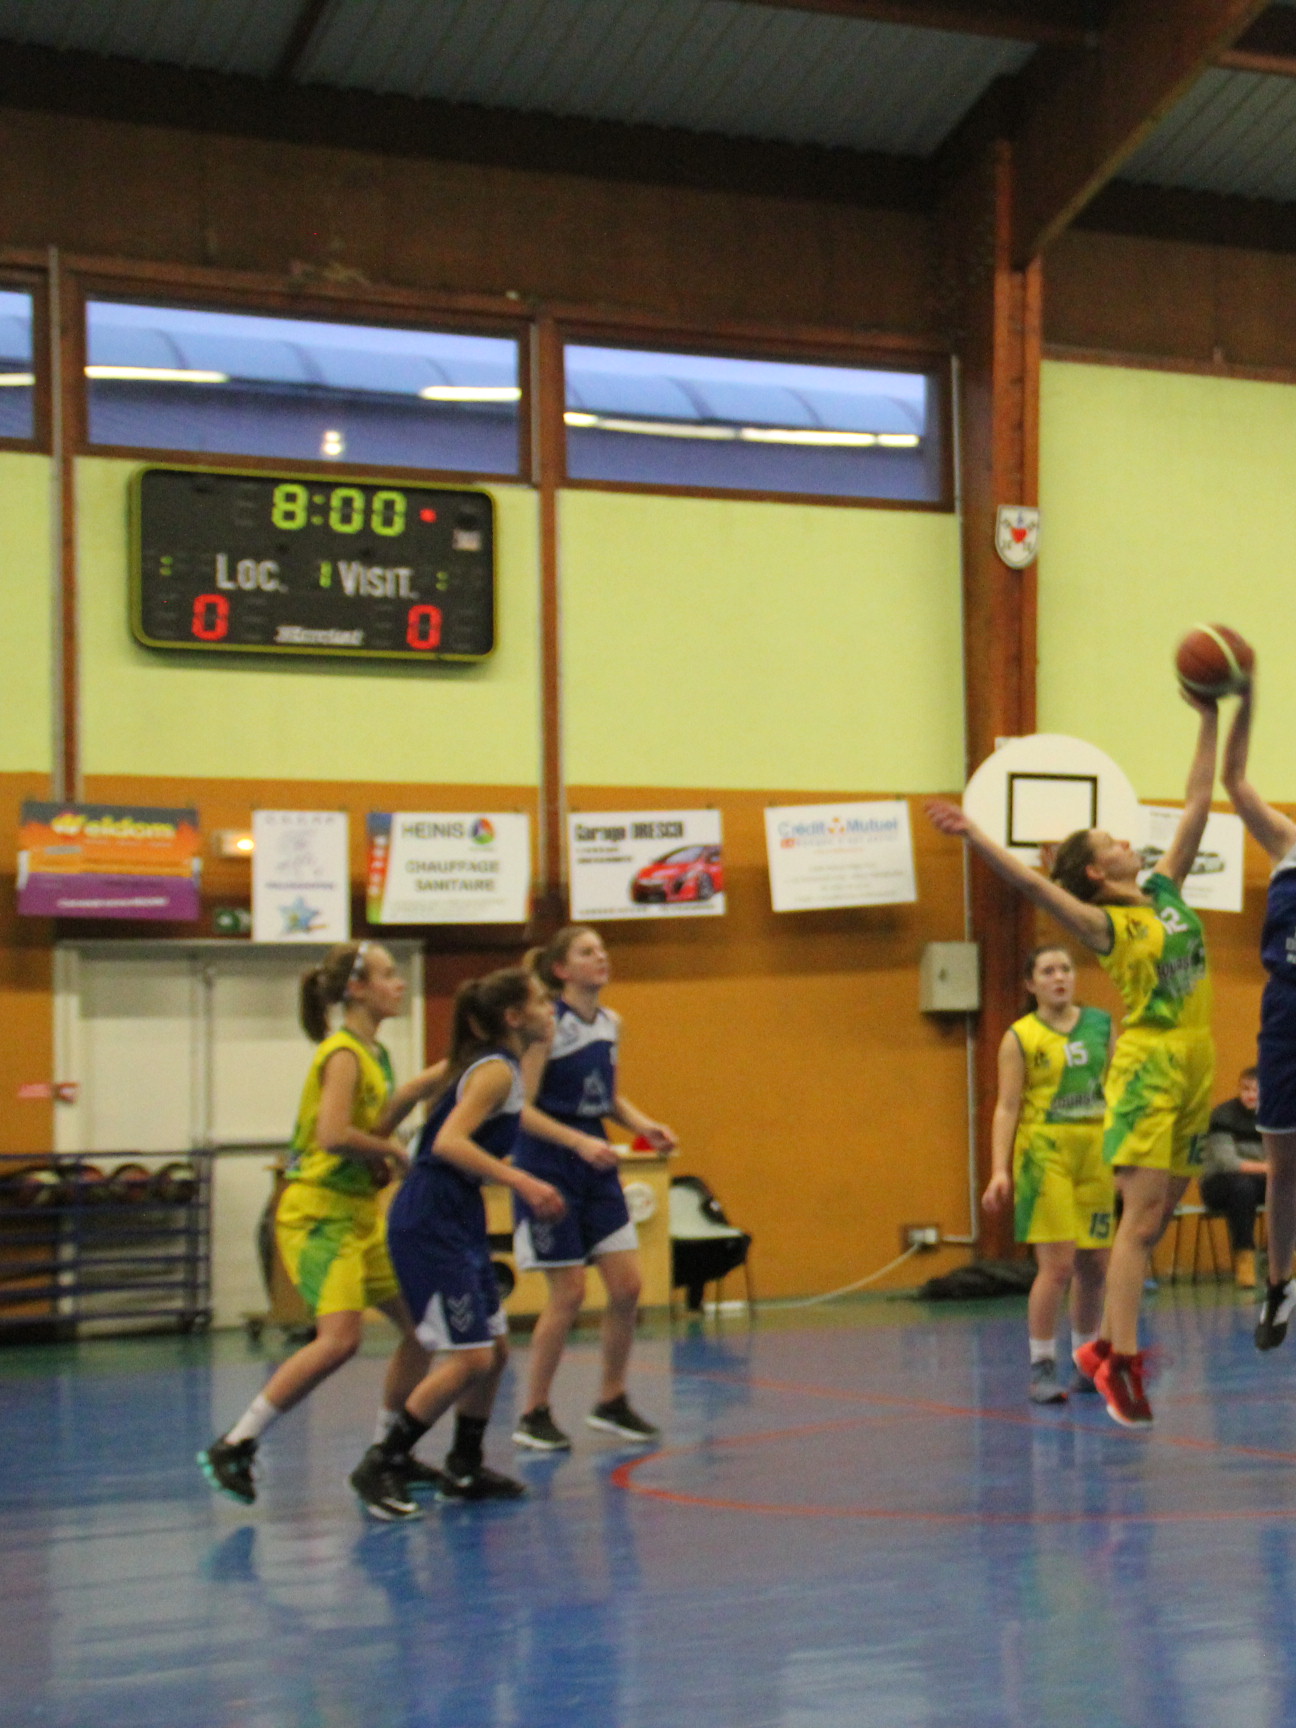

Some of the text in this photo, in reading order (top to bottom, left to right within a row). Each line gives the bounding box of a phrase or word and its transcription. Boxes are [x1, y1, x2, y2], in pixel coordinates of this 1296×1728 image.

[271, 483, 407, 537] 8:00
[191, 593, 230, 640] 0
[406, 604, 443, 649] 0
[400, 821, 466, 840] HEINIS
[405, 859, 501, 874] CHAUFFAGE
[415, 878, 496, 893] SANITAIRE
[1063, 1040, 1089, 1068] 15
[1089, 1211, 1111, 1240] 15
